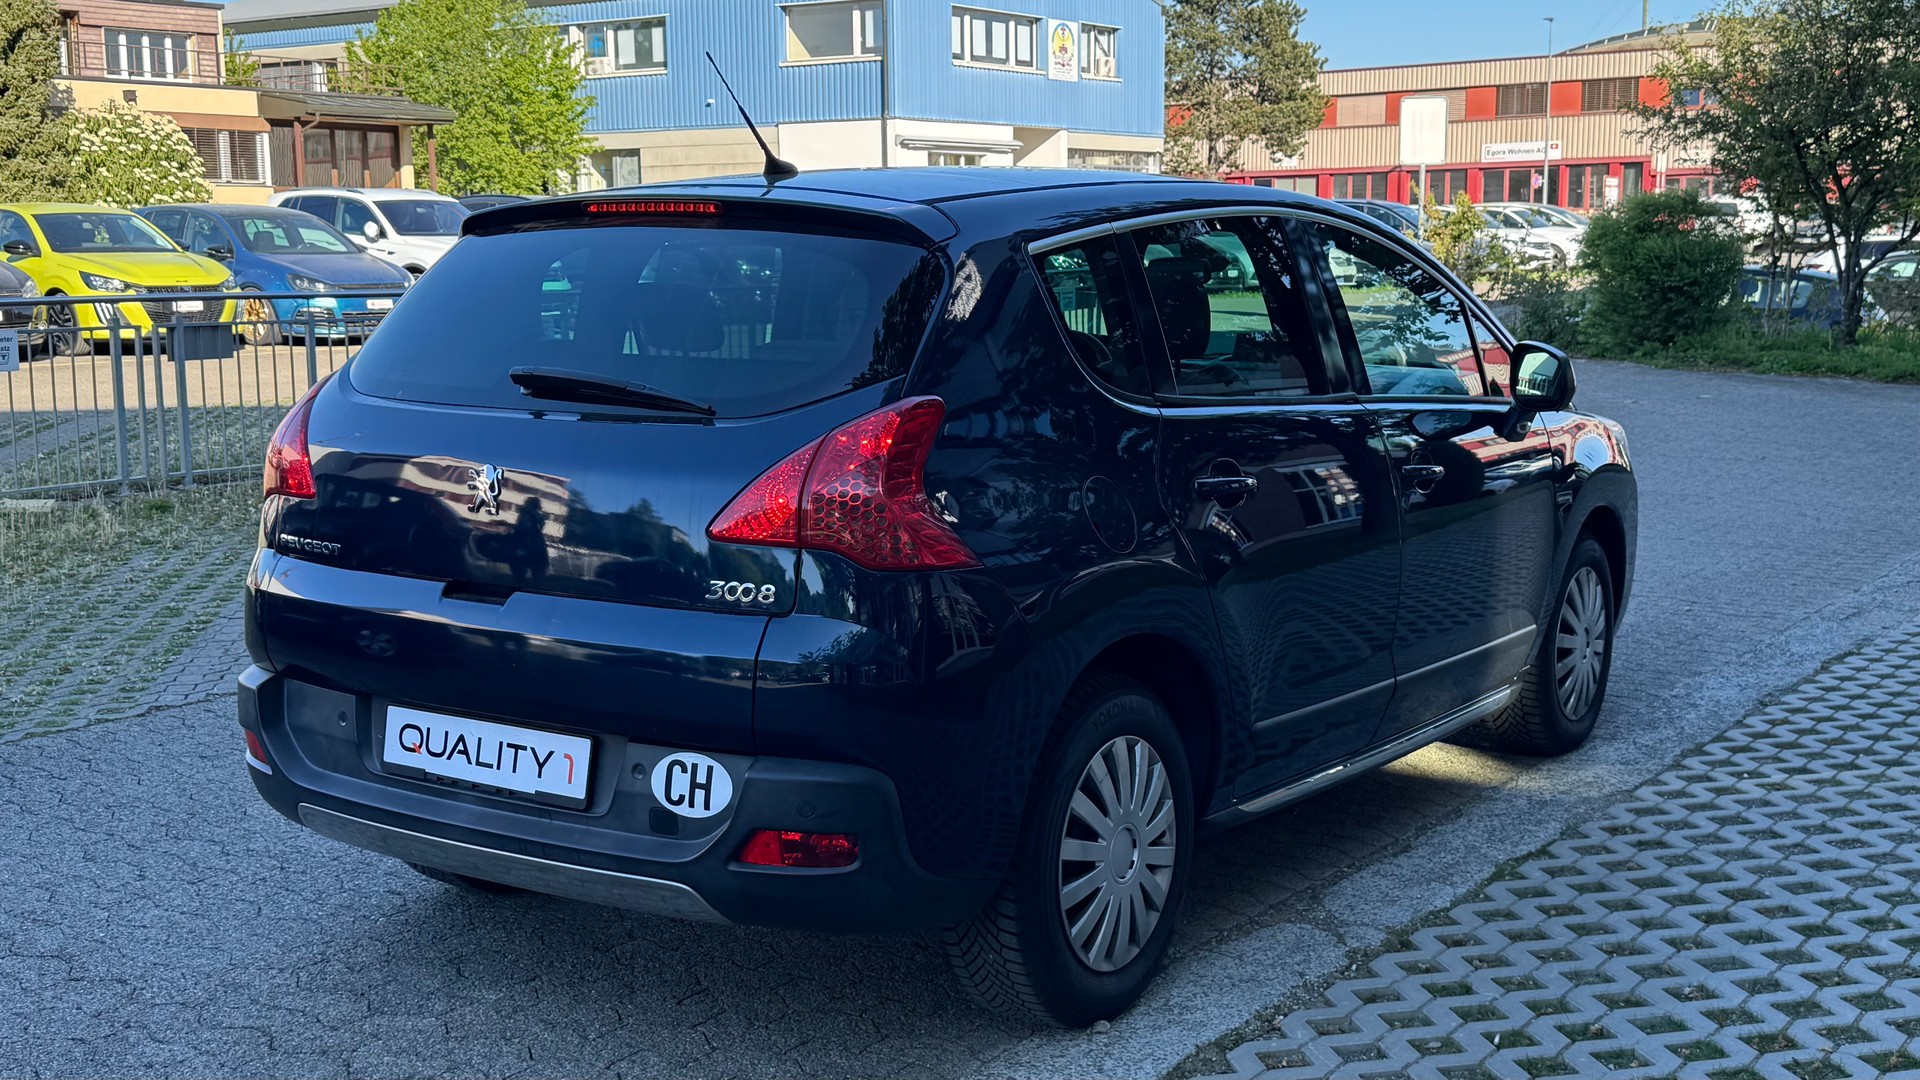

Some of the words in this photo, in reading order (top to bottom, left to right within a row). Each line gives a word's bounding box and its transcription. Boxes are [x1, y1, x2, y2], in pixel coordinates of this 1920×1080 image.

[1486, 149, 1506, 157] Egora
[280, 533, 341, 556] PEUGEOT
[705, 580, 776, 604] 3008
[398, 723, 555, 779] QUALITY
[563, 753, 574, 785] 1
[664, 759, 714, 812] CH
